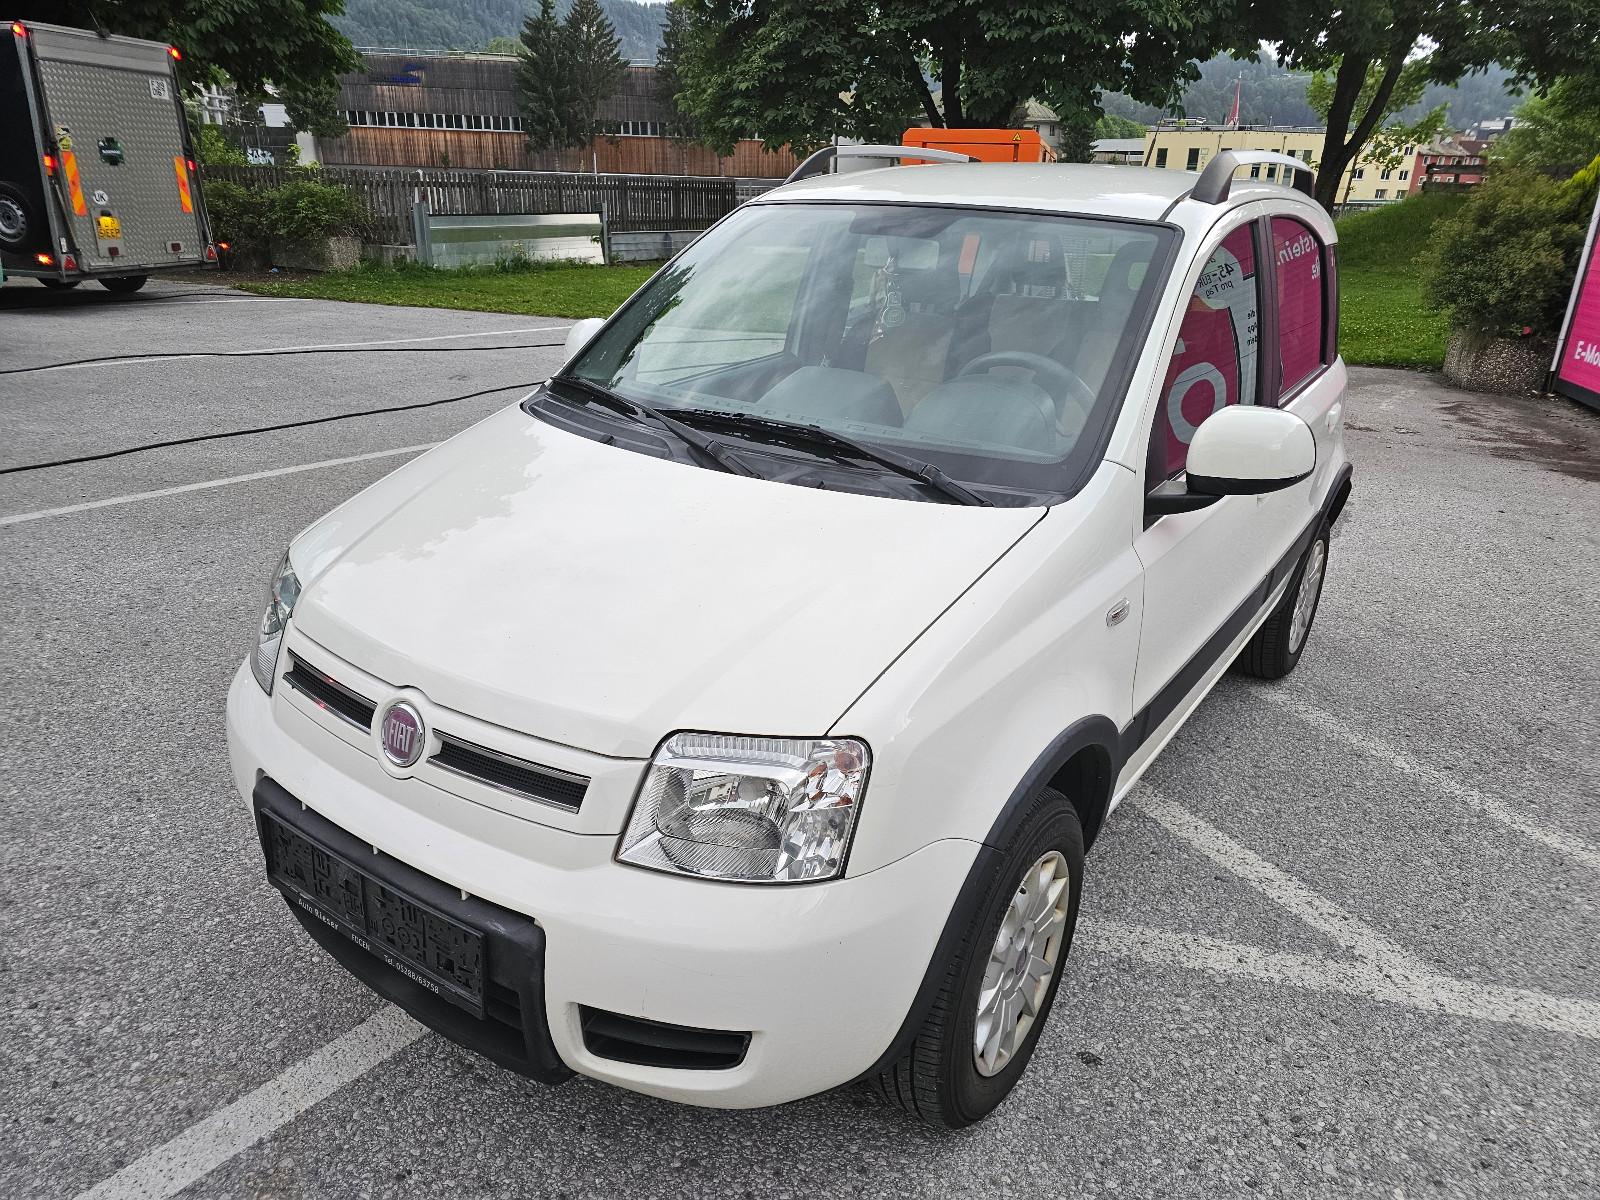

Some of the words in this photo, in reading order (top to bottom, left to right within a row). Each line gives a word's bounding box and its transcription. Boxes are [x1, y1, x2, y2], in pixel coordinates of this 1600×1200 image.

[1574, 340, 1600, 368] E-Mo
[389, 718, 415, 753] FIAT
[298, 898, 313, 913] Auto
[314, 908, 339, 930] Rieser
[383, 954, 395, 967] Tel.
